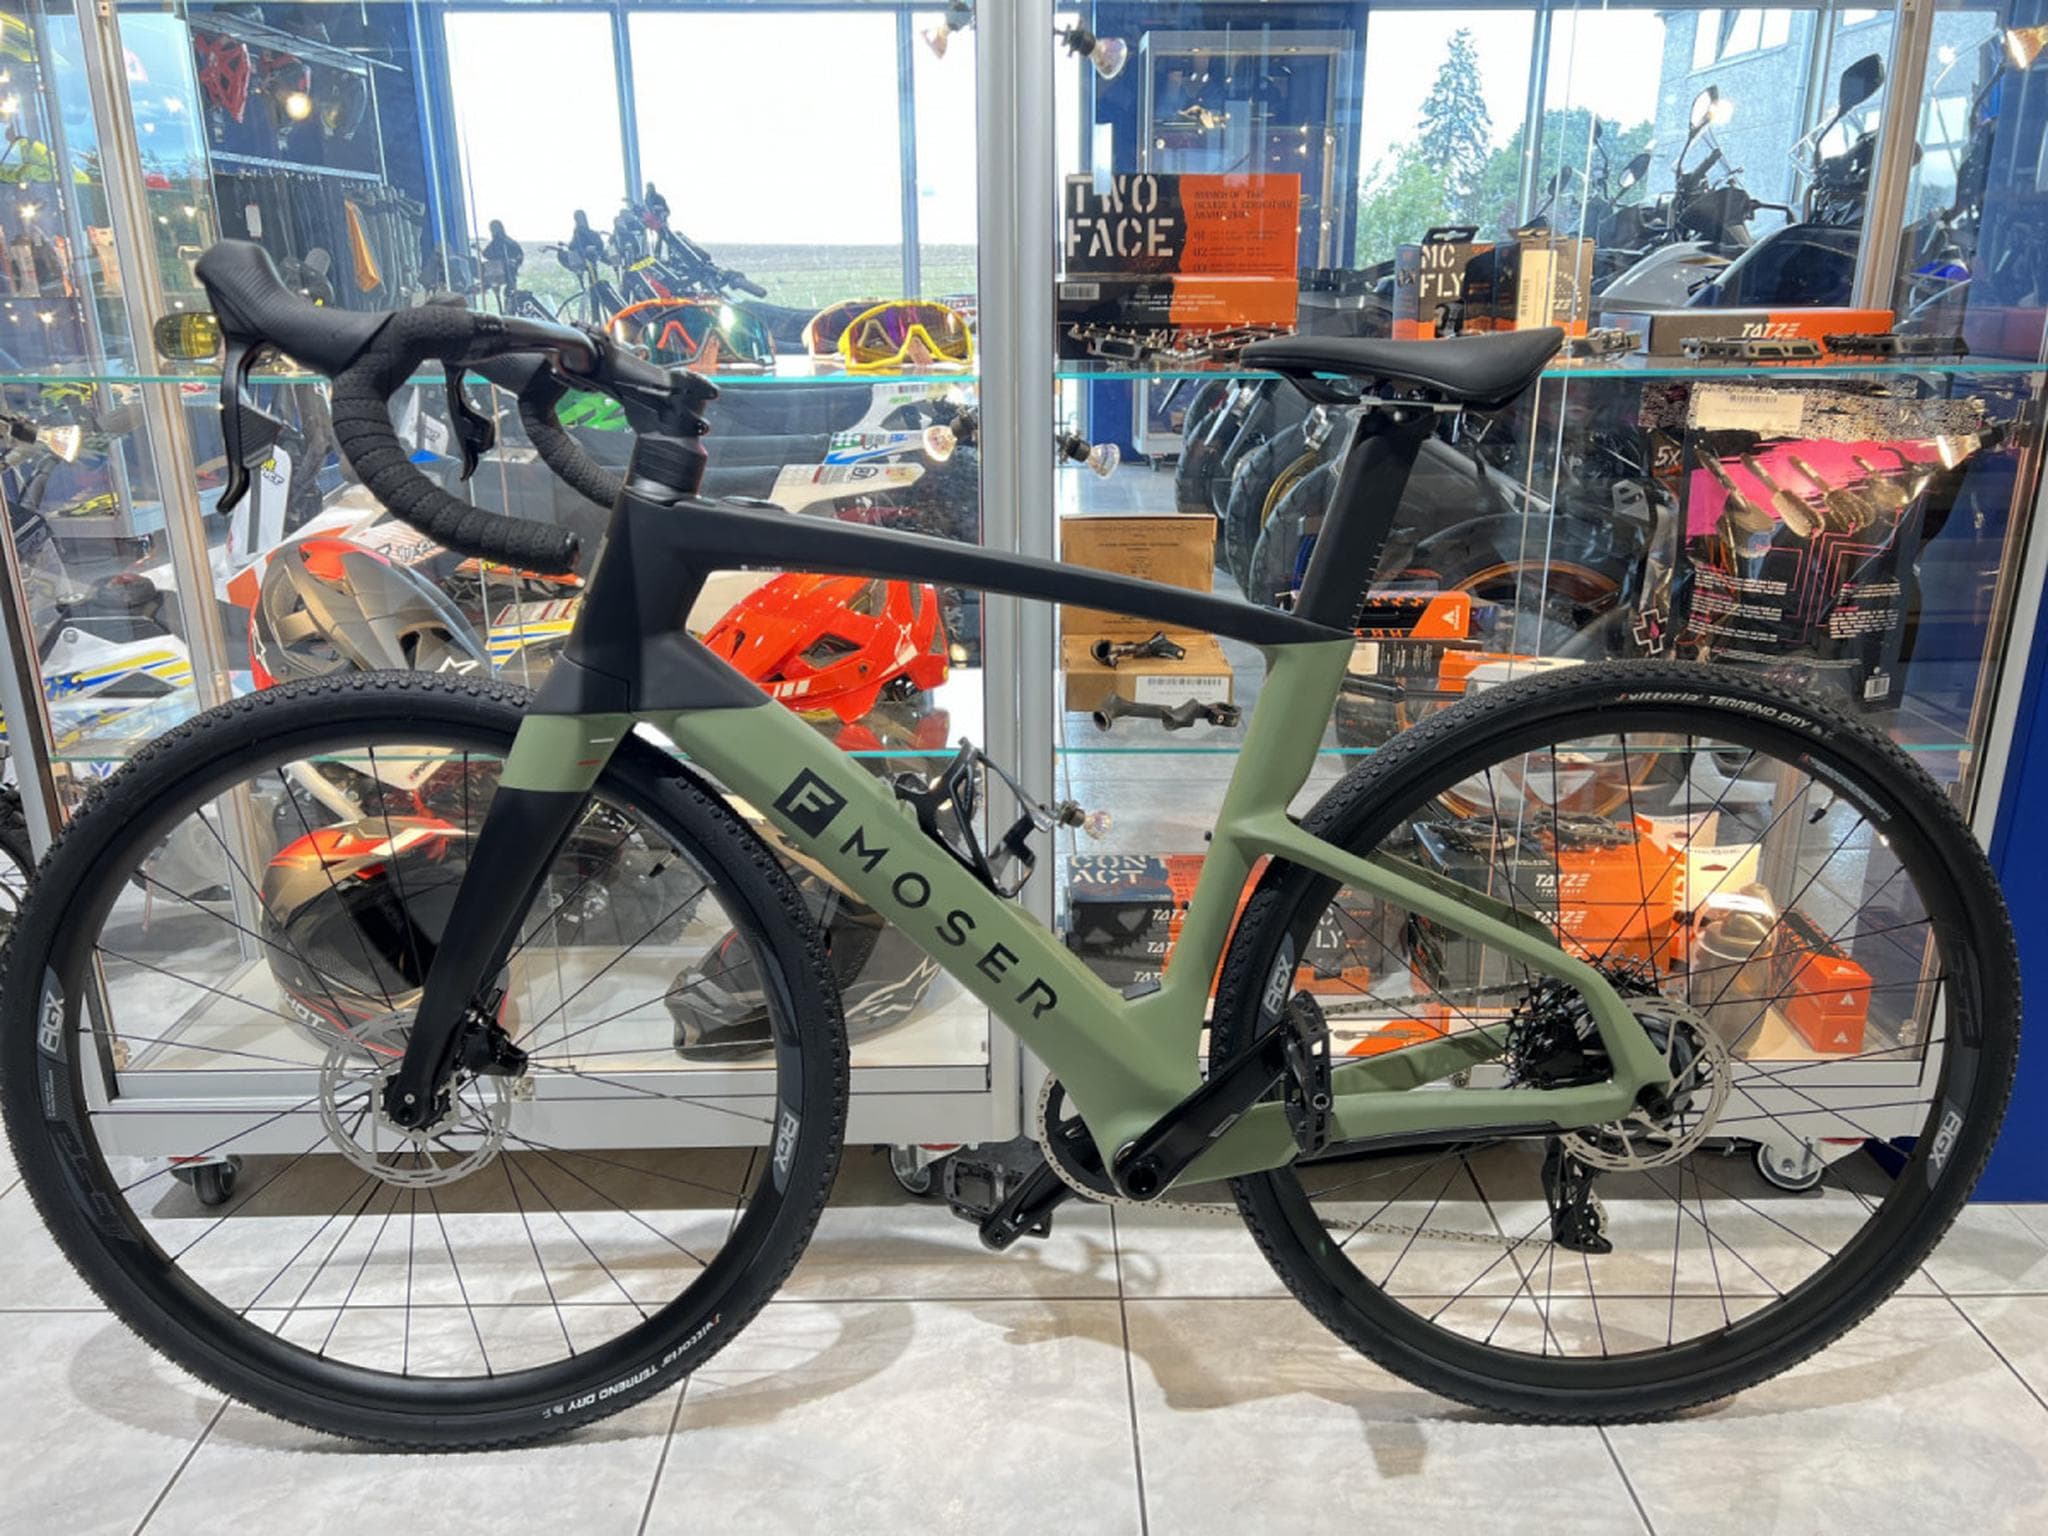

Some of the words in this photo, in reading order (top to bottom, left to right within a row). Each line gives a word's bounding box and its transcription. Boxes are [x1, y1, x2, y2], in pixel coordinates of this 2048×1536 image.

[1067, 174, 1157, 213] TWO
[1067, 218, 1174, 256] FACE
[1421, 244, 1455, 269] MC
[1420, 272, 1465, 298] FLY
[1741, 322, 1800, 338] TATZE
[1654, 445, 1681, 467] 5X
[1628, 692, 1699, 701] vittoria
[1708, 695, 1778, 717] TERRENO
[1777, 711, 1812, 729] DRY
[1070, 855, 1148, 869] CON
[1072, 869, 1144, 885] ACT
[1535, 872, 1592, 888] TATZE
[839, 826, 1058, 1019] MOSER
[1534, 910, 1588, 925] TATZE
[1147, 941, 1176, 954] TAT
[1316, 929, 1344, 949] LY
[1133, 971, 1164, 983] TAT
[662, 1320, 715, 1367] vittoria
[598, 1364, 659, 1401] TERRENO
[567, 1392, 596, 1412] DRY
